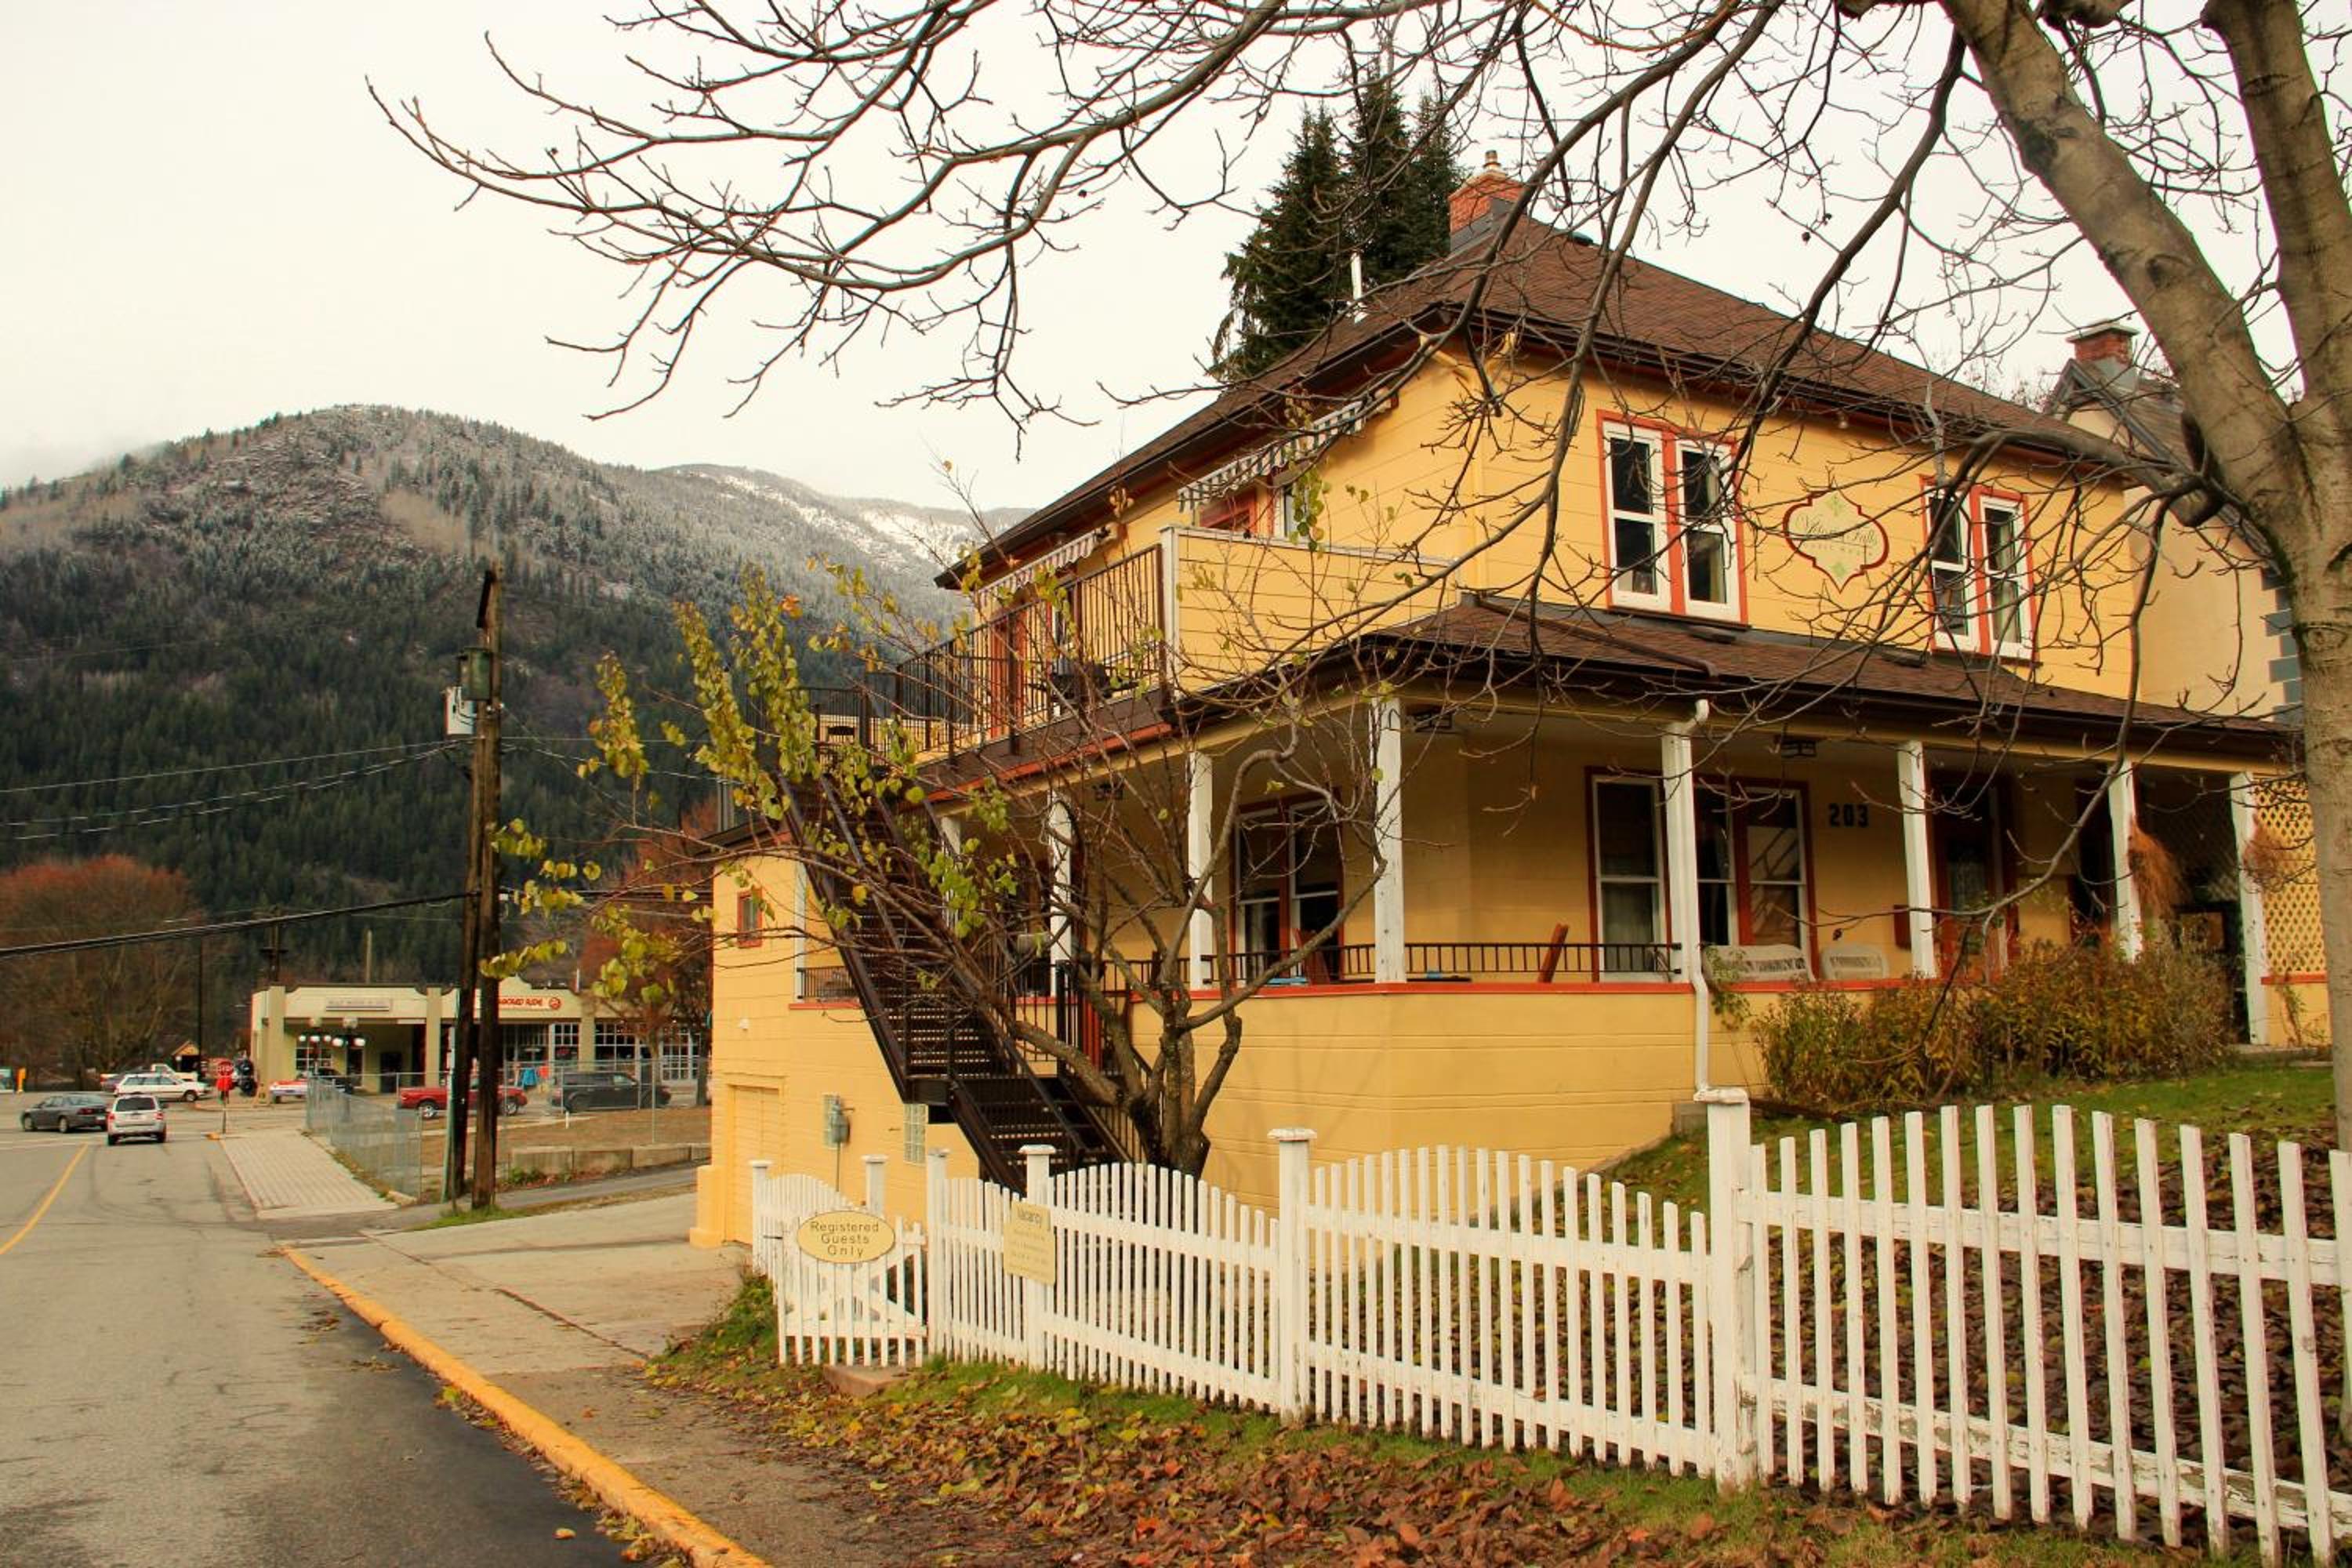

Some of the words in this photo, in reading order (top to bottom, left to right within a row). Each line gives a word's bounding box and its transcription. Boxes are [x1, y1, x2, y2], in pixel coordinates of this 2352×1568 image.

[1828, 803, 1868, 827] 203
[810, 1221, 879, 1234] Registered
[821, 1232, 869, 1244] Guests
[827, 1244, 864, 1258] Only
